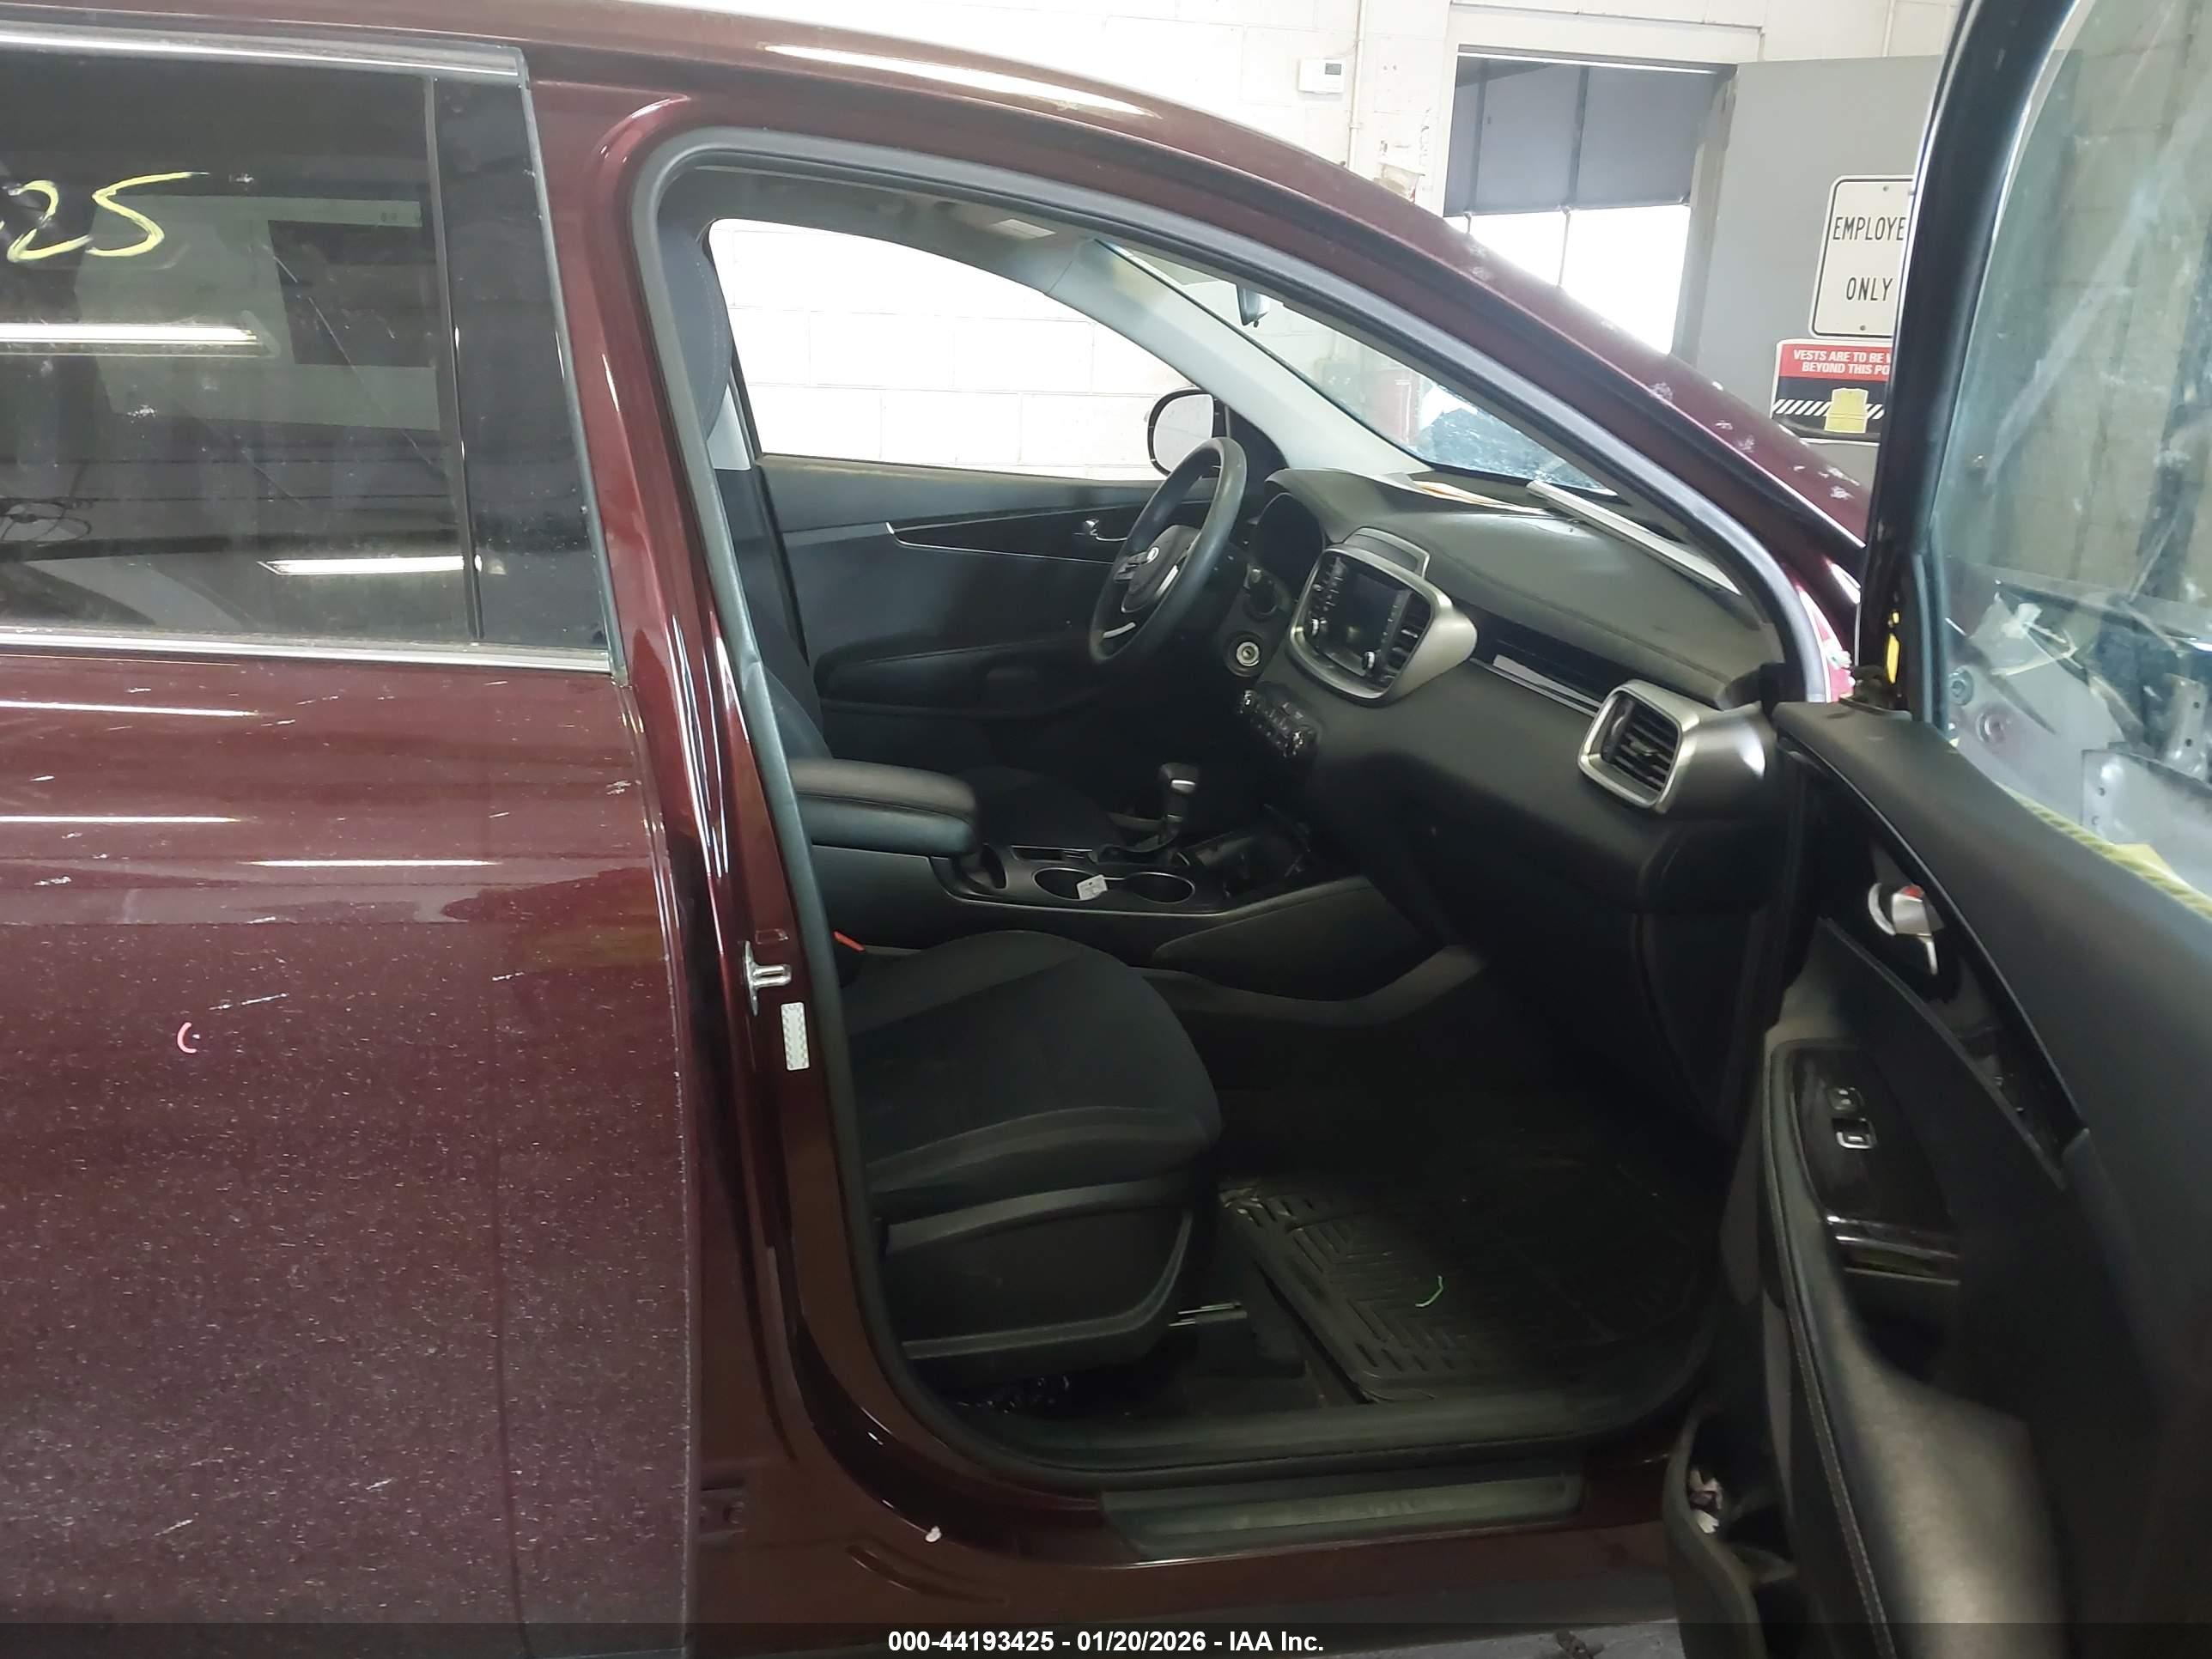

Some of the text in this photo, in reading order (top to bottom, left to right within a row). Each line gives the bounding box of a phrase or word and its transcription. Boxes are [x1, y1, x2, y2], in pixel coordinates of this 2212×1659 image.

[0, 172, 210, 263] 25
[1832, 216, 1906, 240] EMPLOYE
[1846, 276, 1893, 301] ONLY
[1793, 349, 1827, 361] VESTS
[1828, 351, 1850, 362] ARE
[1853, 352, 1867, 362] TO
[1869, 353, 1884, 363] BE
[1802, 362, 1889, 375] BEYOND THIS PO
